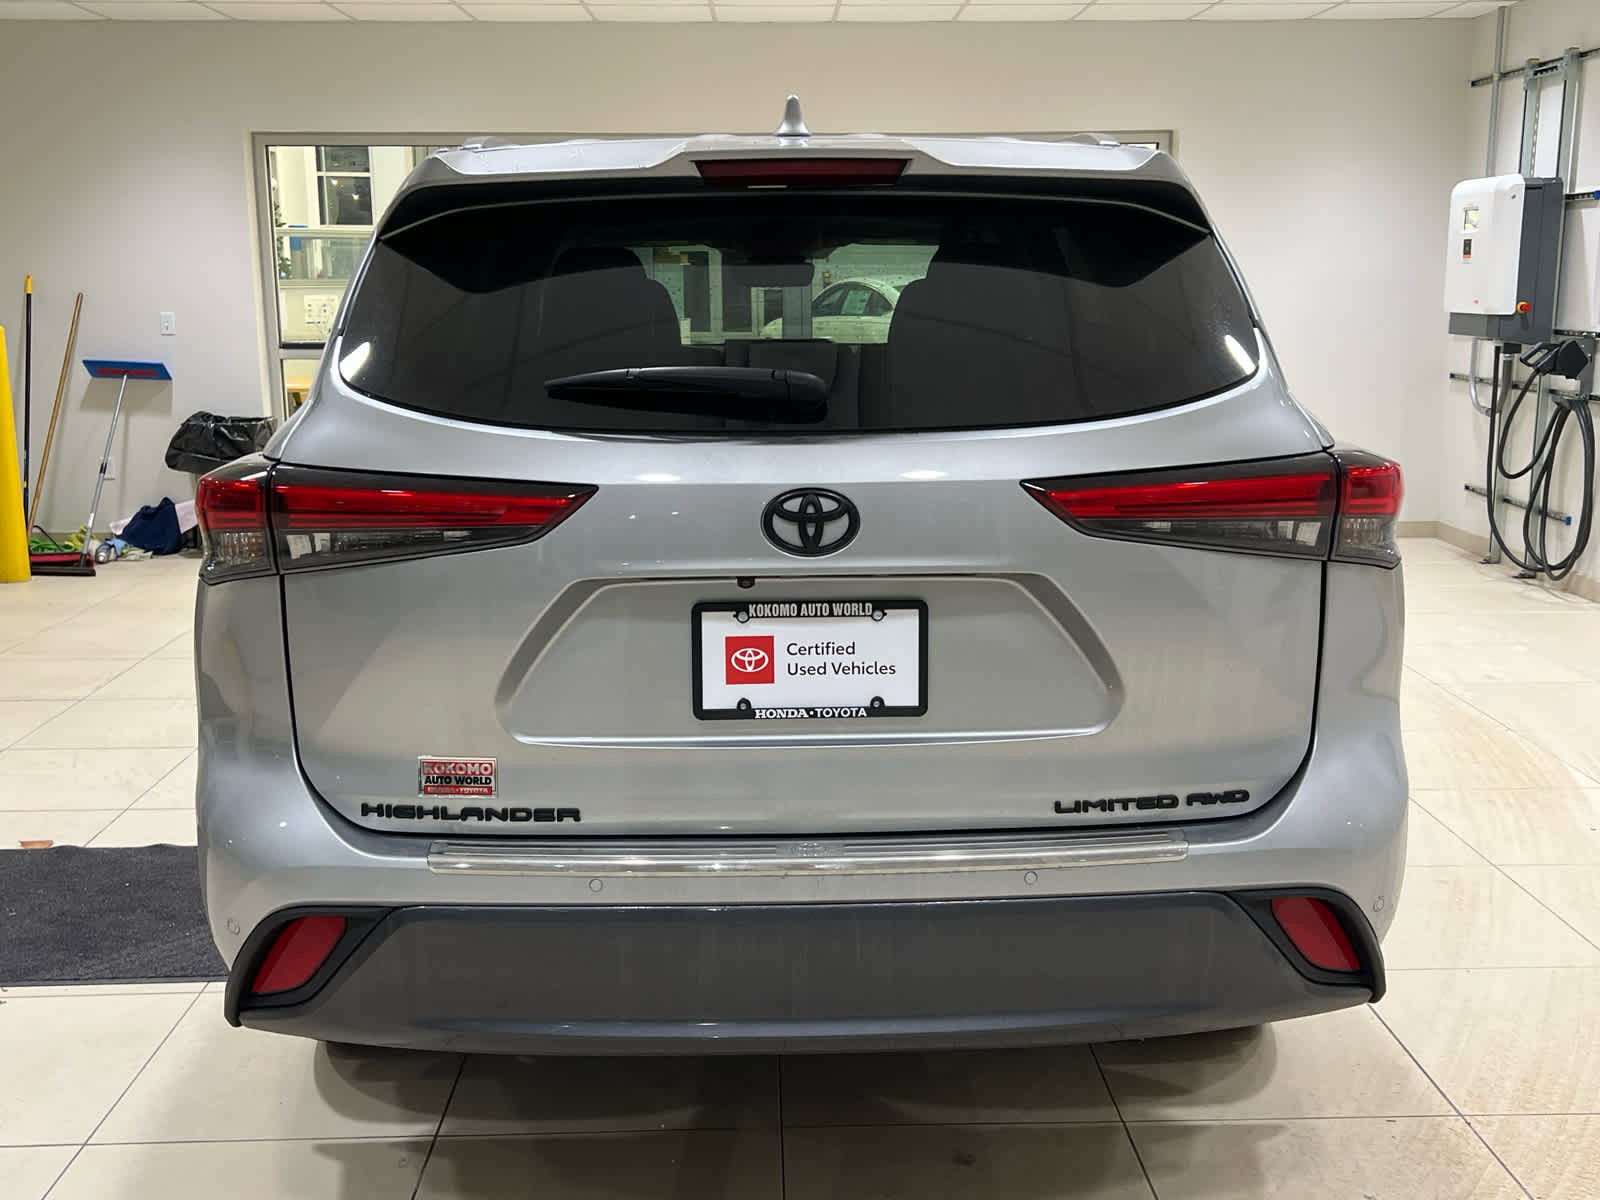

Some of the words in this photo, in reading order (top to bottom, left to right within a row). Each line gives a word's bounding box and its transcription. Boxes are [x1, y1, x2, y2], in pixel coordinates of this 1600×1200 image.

[748, 603, 798, 617] KOKOMO
[800, 603, 830, 617] AUTO
[832, 602, 873, 616] WORLD
[786, 641, 856, 656] Certified
[787, 662, 827, 676] Used
[831, 661, 896, 675] Vehicles
[424, 775, 452, 785] AUTO
[454, 776, 492, 785] WORLD
[1054, 794, 1179, 813] LIMITED
[1186, 789, 1250, 806] AWD
[361, 803, 582, 823] HIGHLANDER
